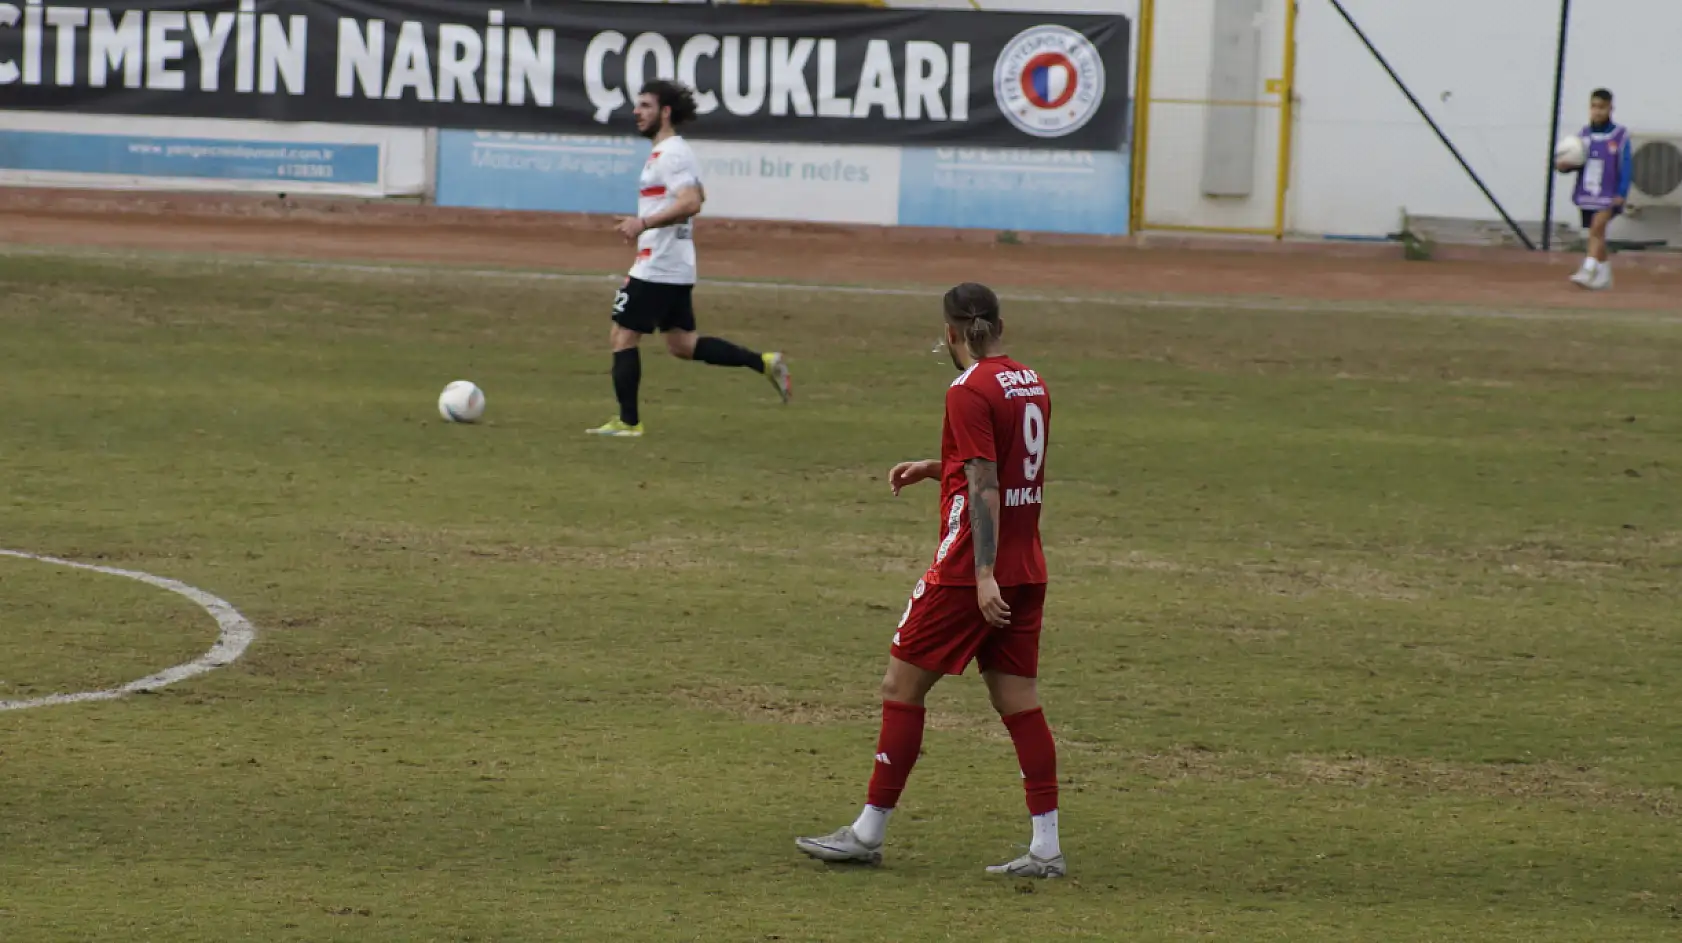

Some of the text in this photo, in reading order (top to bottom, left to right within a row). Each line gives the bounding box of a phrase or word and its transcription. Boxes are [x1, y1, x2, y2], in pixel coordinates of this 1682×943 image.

[336, 10, 554, 106] NARİN
[583, 31, 970, 122] ÇOCUKLARI
[759, 157, 793, 178] bir
[801, 158, 870, 183] nefes
[1022, 402, 1045, 481] 9
